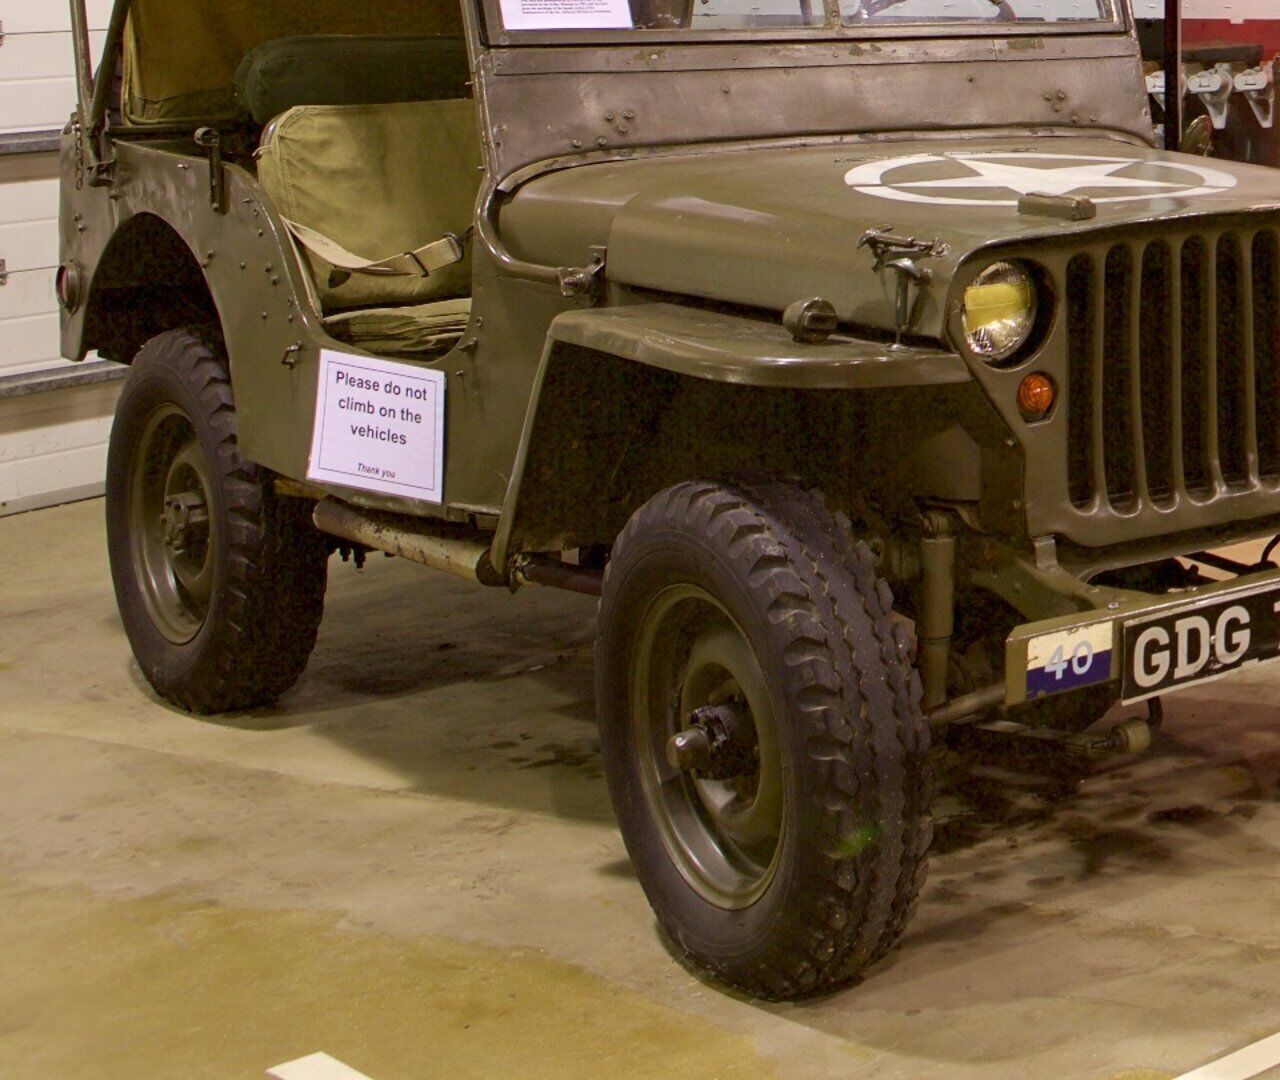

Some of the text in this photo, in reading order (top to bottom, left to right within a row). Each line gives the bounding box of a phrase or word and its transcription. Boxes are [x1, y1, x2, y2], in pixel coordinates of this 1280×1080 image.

[335, 371, 428, 401] Please do not
[338, 397, 422, 424] climb on the
[350, 424, 407, 445] vehicles
[357, 463, 396, 478] Thank you
[1044, 639, 1094, 681] 40
[1133, 606, 1252, 689] GDG
